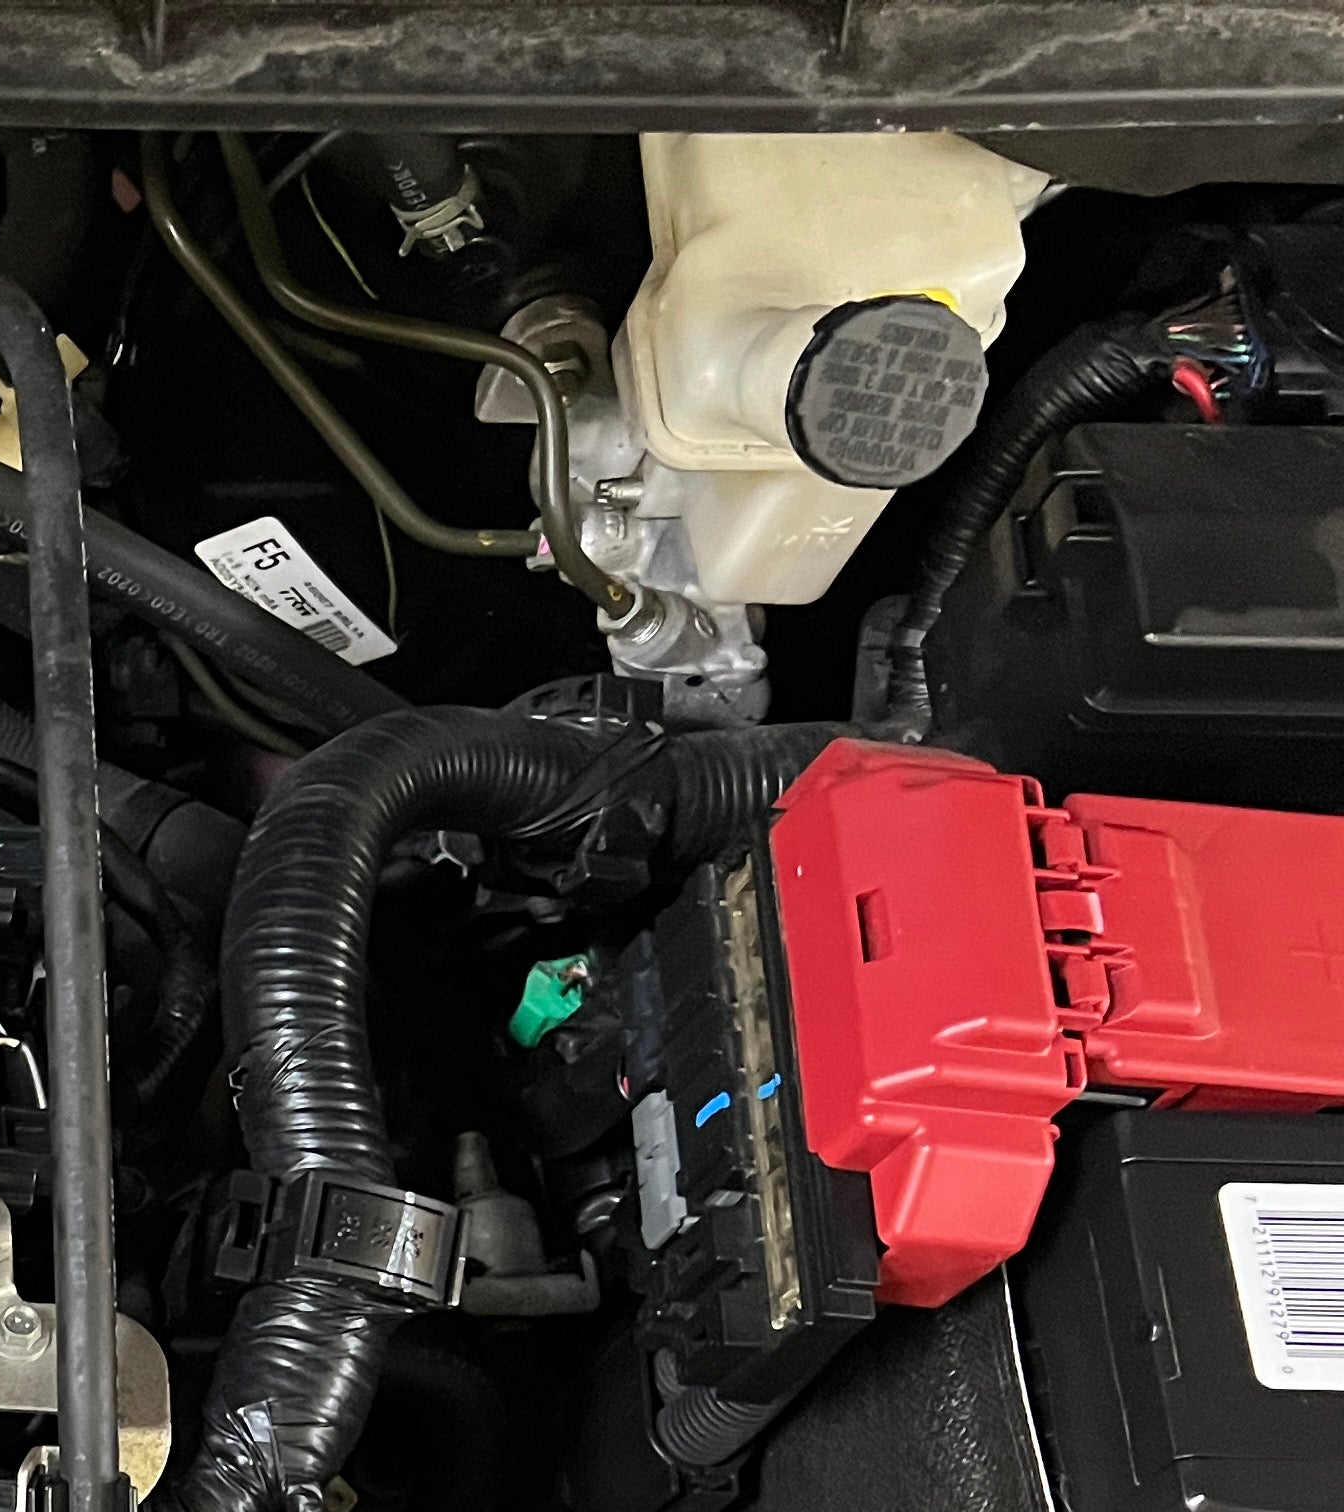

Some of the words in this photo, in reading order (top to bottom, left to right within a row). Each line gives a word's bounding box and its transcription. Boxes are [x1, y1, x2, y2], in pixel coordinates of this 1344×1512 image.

[242, 537, 291, 570] F5
[1252, 1226, 1276, 1278] 21112
[1266, 1287, 1289, 1340] 91279
